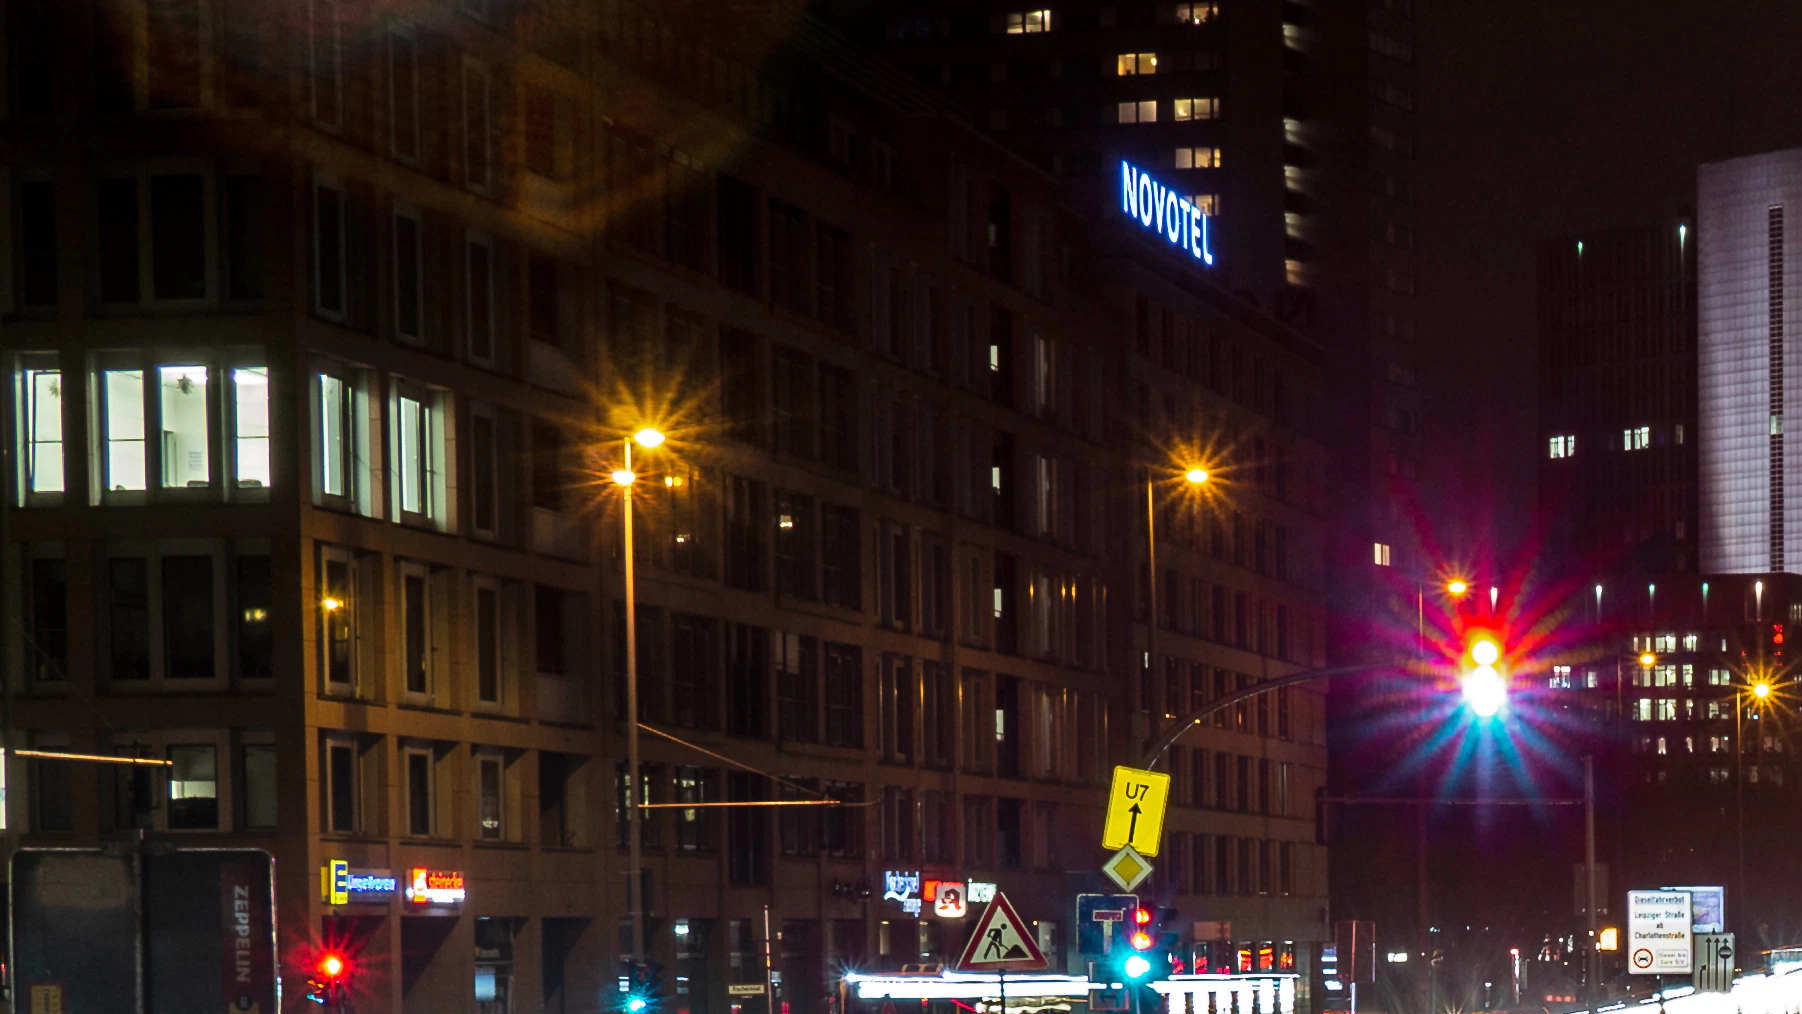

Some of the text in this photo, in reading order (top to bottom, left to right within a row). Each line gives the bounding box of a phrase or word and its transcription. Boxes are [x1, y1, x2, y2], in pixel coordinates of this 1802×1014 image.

[1122, 160, 1213, 265] NOVOTEL
[1125, 781, 1150, 802] U7
[1634, 896, 1685, 904] Dieselfahrverbot
[1634, 910, 1685, 920] Leipziger Straße
[233, 884, 252, 983] ZEPPELIN
[1634, 931, 1685, 939] Charlottenstraße
